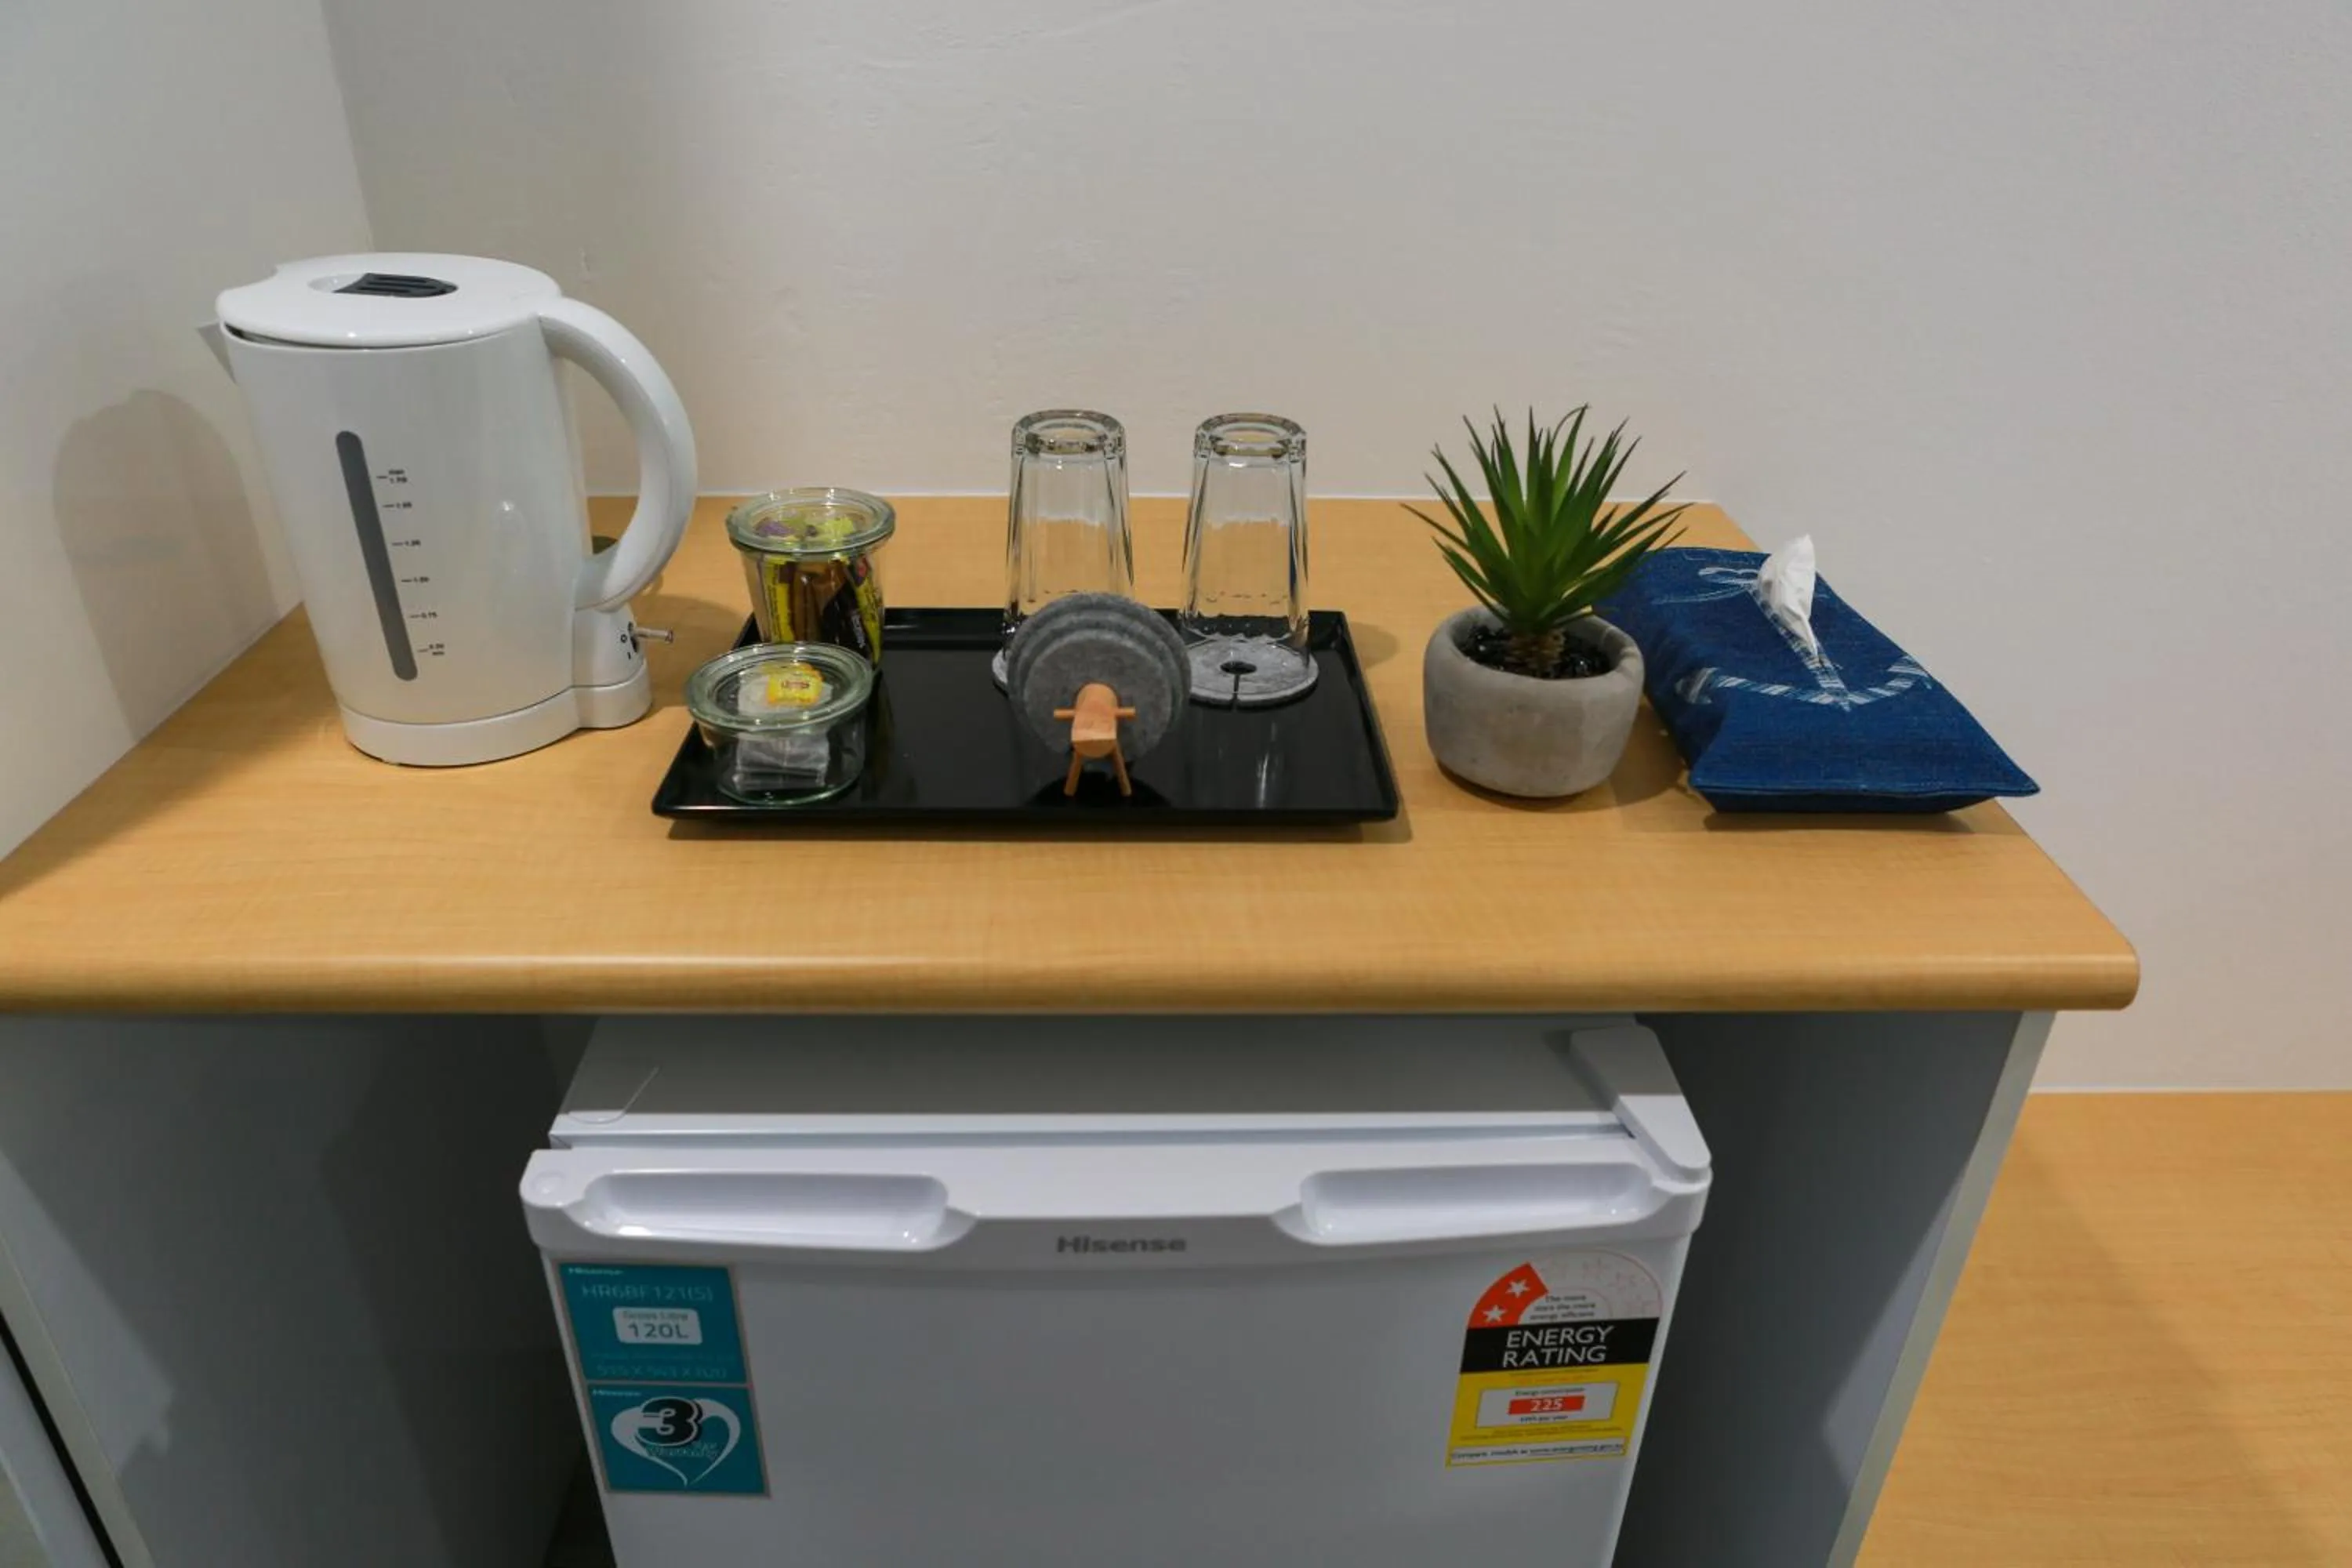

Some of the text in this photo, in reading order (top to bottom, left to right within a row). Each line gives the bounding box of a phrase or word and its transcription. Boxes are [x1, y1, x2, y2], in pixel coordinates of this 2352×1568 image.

[1057, 1235, 1187, 1254] Hisense
[628, 1323, 690, 1339] 120L
[1506, 1325, 1615, 1348] ENERGY
[1503, 1345, 1607, 1368] RATING
[1530, 1398, 1565, 1412] 225
[635, 1396, 702, 1447] 3
